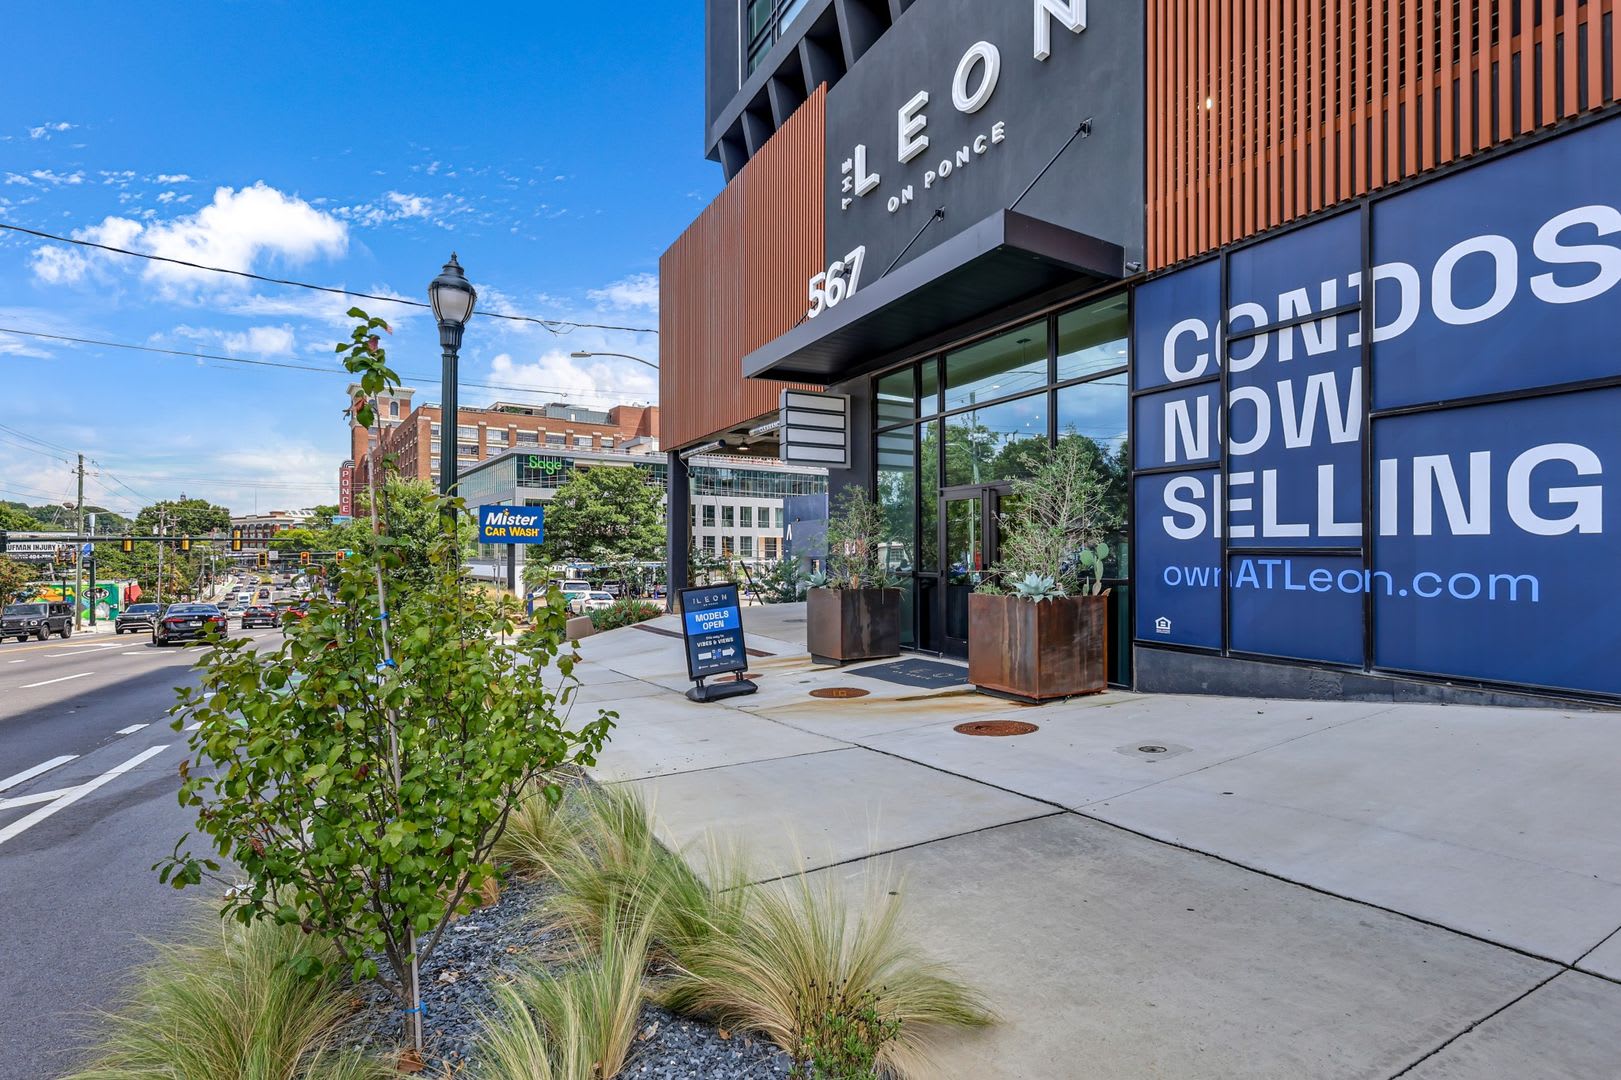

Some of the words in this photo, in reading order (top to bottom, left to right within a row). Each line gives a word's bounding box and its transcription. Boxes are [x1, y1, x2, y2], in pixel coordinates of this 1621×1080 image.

[855, 0, 1087, 197] LEON
[841, 158, 853, 210] THE
[887, 185, 914, 214] ON
[924, 121, 1005, 189] PONCE
[808, 245, 866, 318] 567
[1163, 205, 1621, 383] CONDOS
[1164, 366, 1362, 464] NOW
[529, 455, 562, 475] Sage
[1162, 442, 1603, 541] SELLING
[485, 511, 538, 526] Mister
[485, 526, 506, 536] CAR
[509, 526, 538, 537] WASH
[1163, 558, 1540, 603] ownATLeon.com
[695, 610, 729, 622] MODELS
[702, 620, 725, 630] OPEN
[697, 640, 712, 648] VIBES
[718, 637, 734, 645] VIEWS
